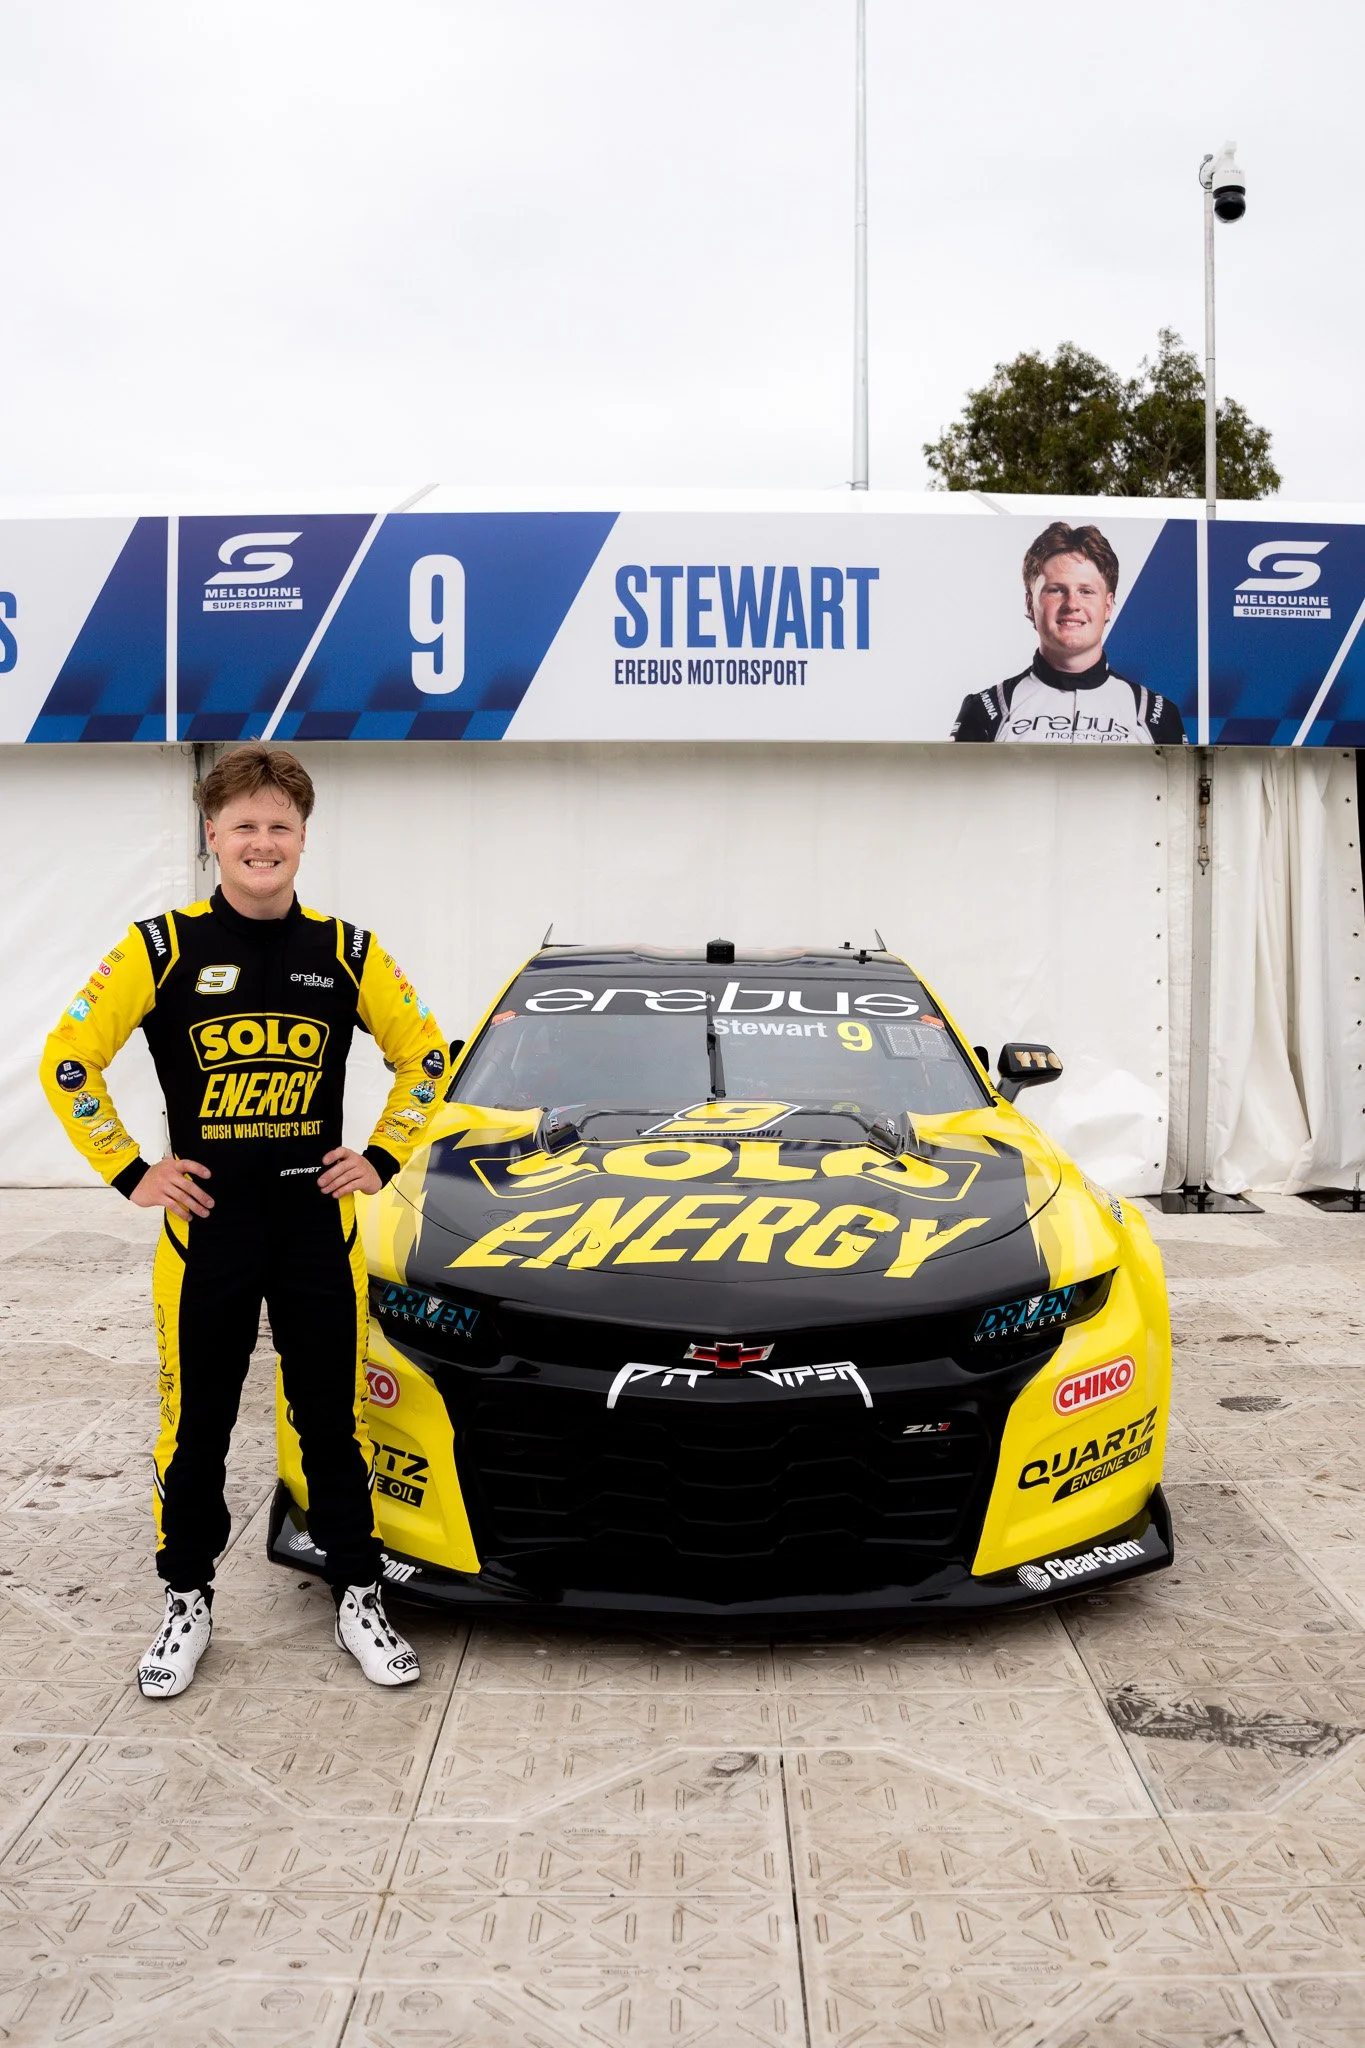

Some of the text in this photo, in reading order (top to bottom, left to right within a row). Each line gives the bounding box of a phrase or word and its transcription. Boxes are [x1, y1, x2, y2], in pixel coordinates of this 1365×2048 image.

[205, 587, 301, 598] MELBOURNE
[212, 601, 293, 609] SUPERSPRINT
[614, 564, 880, 650] STEWART
[1235, 594, 1329, 606] MELBOURNE
[409, 554, 466, 695] 9
[1242, 608, 1322, 617] SUPERSPRINT
[614, 659, 808, 686] EREBUS MOTORSPORT
[195, 965, 241, 995] 9
[290, 972, 335, 985] erebus
[525, 982, 920, 1017] erebus
[200, 1019, 321, 1061] SOLO
[713, 1018, 874, 1052] Stewart 9
[198, 1071, 323, 1118] ENERGY
[202, 1124, 232, 1139] CRUSH
[301, 1120, 321, 1136] NEXT
[640, 1101, 803, 1136] 9
[280, 1166, 321, 1176] STEWART
[506, 1142, 951, 1188] SOLO
[444, 1195, 993, 1278] ENERGY
[378, 1305, 473, 1339] WORKWEAR
[974, 1312, 1067, 1342] WORKWEAR
[748, 1361, 873, 1408] VIPER
[1058, 1362, 1131, 1409] CHIKO
[1017, 1405, 1158, 1490] QUARTZ
[1070, 1441, 1148, 1493] ENGINE OIL
[389, 1481, 417, 1503] OIL
